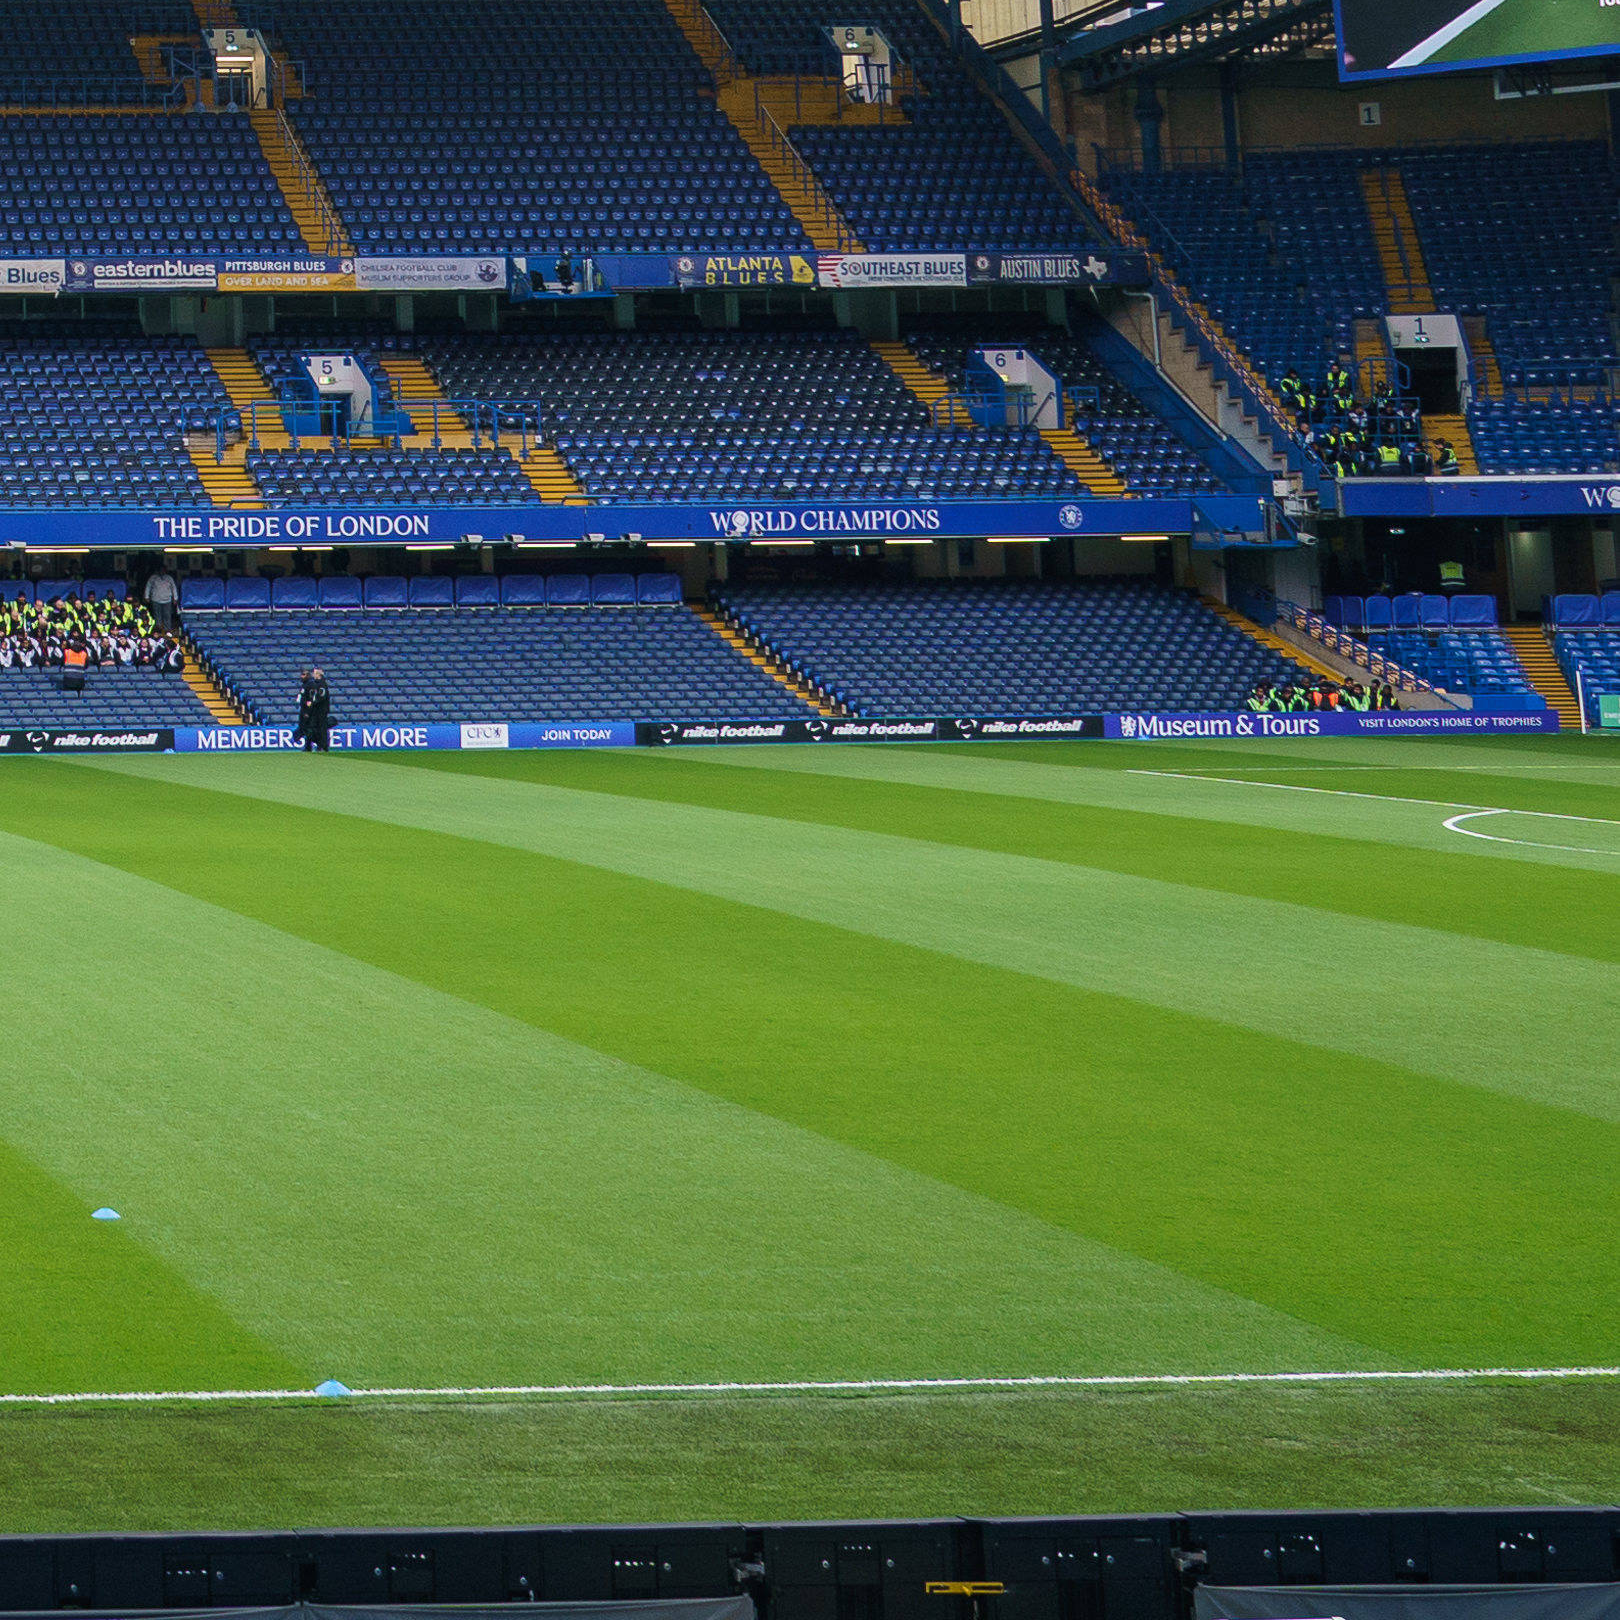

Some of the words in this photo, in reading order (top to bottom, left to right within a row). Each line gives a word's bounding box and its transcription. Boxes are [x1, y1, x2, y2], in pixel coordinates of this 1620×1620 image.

[225, 30, 235, 44] 5
[845, 27, 855, 41] 6
[93, 260, 216, 277] easternblues
[225, 261, 291, 271] PITTSBURGH
[294, 261, 326, 271] BLUES
[706, 256, 783, 271] ATLANTA
[924, 261, 964, 276] BLUES
[1000, 259, 1041, 278] AUSTIN
[1044, 259, 1080, 278] BLUES
[7, 268, 60, 284] Blues
[225, 277, 252, 286] OVER
[256, 277, 283, 286] LAND
[286, 277, 307, 286] AND
[311, 277, 329, 286] SEA
[705, 272, 784, 285] BLUES
[1414, 317, 1427, 335] 1
[995, 353, 1006, 367] 6
[322, 360, 333, 375] 5
[153, 517, 202, 538] THE
[209, 517, 280, 538] PRIDE
[285, 516, 320, 537] OF
[327, 515, 429, 537] LONDON
[710, 511, 796, 533] WORLD
[800, 510, 940, 532] CHAMPIONS
[832, 723, 869, 735] nike
[869, 723, 935, 735] football
[982, 721, 1018, 732] nike
[1018, 720, 1084, 732] football
[1137, 715, 1232, 736] Museum
[1236, 715, 1255, 735] &
[1256, 714, 1320, 735] Tours
[1359, 718, 1384, 728] VISIT
[1387, 718, 1439, 727] LONDON'S
[1442, 718, 1472, 727] HOME
[1475, 717, 1489, 727] OF
[1492, 717, 1542, 726] TROPHIES
[327, 728, 357, 747] ET
[362, 728, 428, 747] MORE
[541, 729, 571, 741] JOIN
[573, 729, 612, 740] TODAY
[683, 726, 719, 737] nike
[720, 725, 785, 737] football
[53, 734, 91, 746] nike
[91, 733, 158, 745] football
